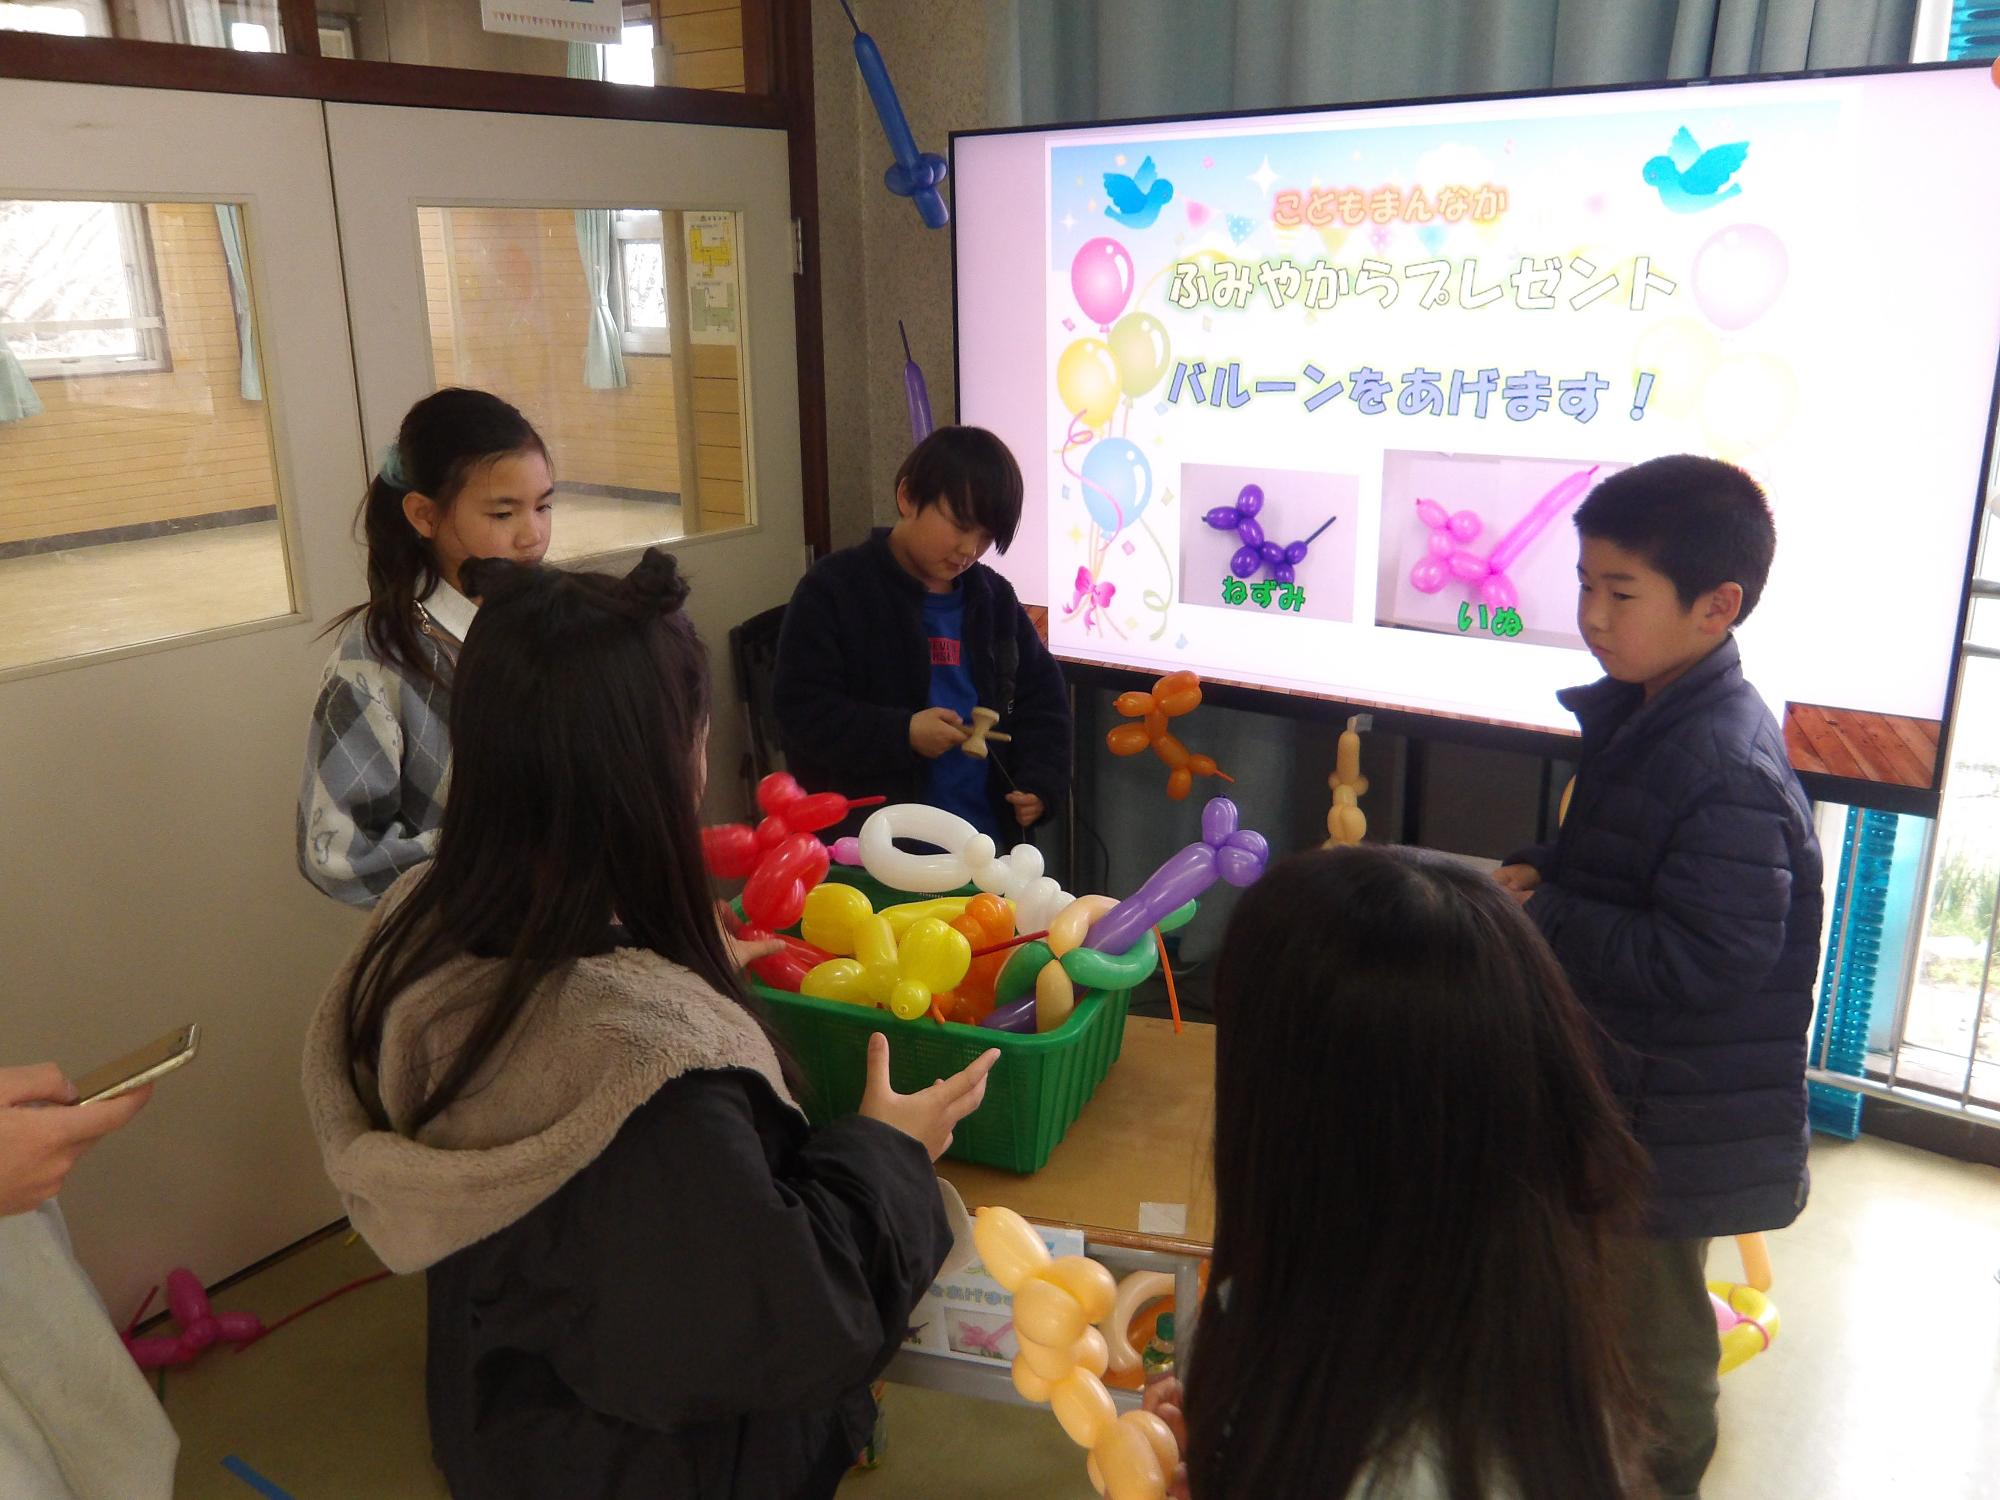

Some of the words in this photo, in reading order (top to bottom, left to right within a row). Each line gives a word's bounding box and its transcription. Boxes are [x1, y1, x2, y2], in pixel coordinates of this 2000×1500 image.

[1274, 186, 1507, 225] こどもまんなか
[1169, 257, 1676, 310] ふみやからプレゼント
[1222, 576, 1305, 611] ねずみ
[1458, 601, 1523, 637] いぬ
